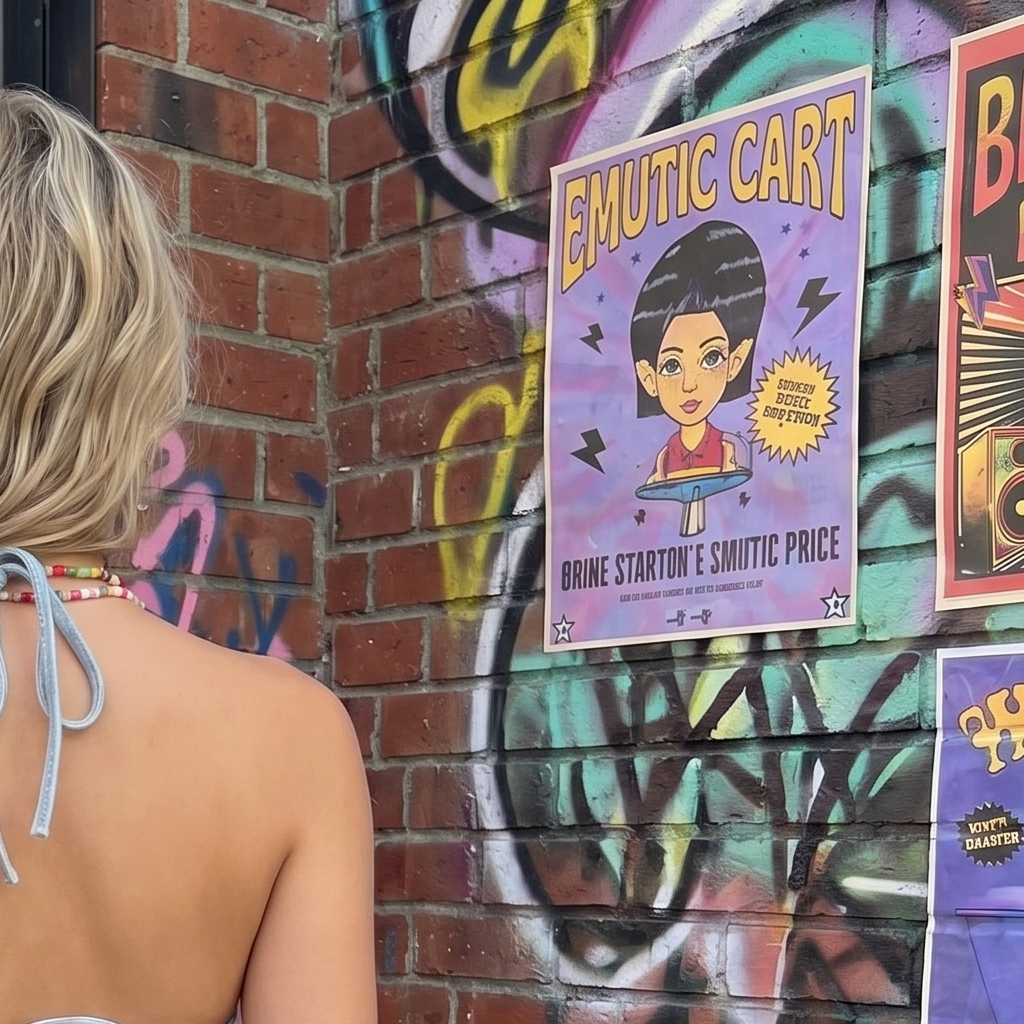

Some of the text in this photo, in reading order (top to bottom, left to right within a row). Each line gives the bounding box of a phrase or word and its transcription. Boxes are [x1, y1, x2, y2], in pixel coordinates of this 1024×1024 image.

[561, 90, 856, 294] EMUTIC CART
[785, 525, 840, 565] PRICE
